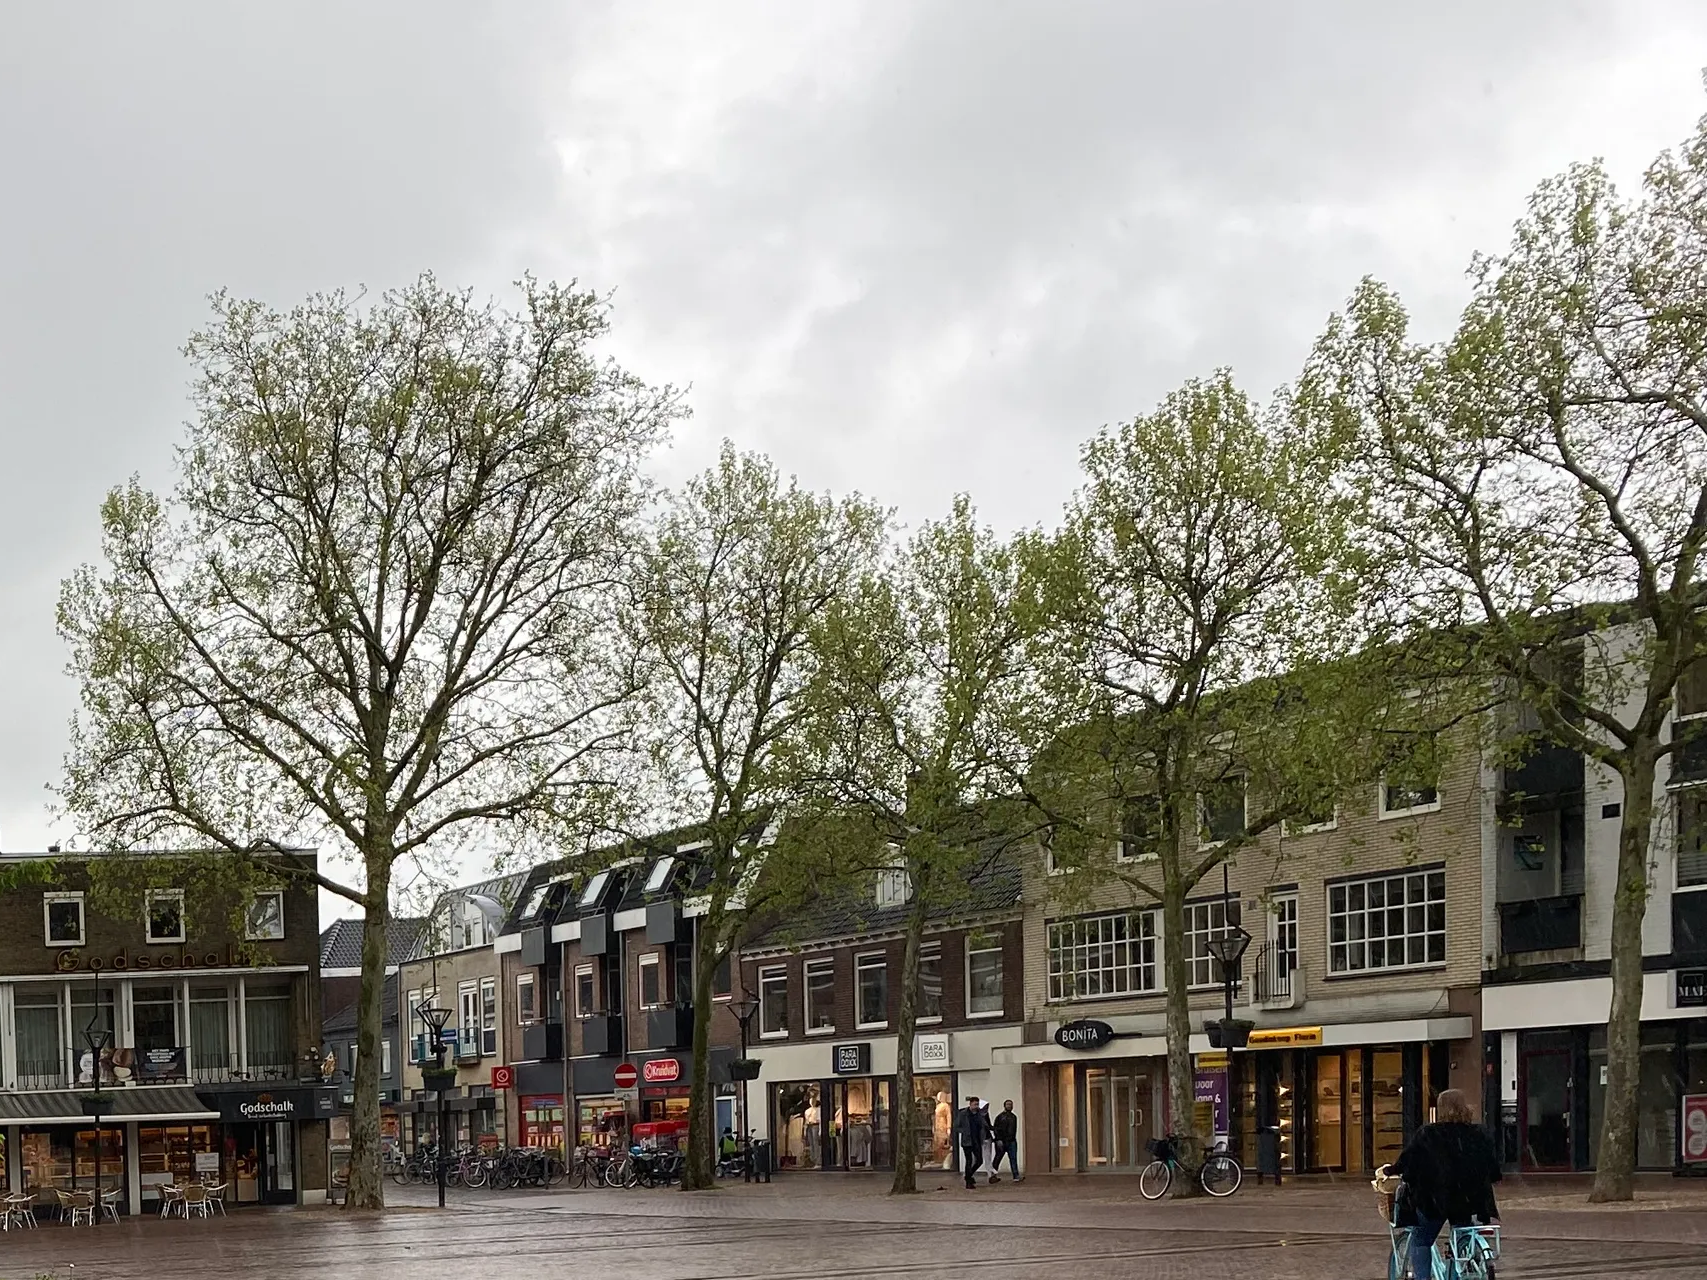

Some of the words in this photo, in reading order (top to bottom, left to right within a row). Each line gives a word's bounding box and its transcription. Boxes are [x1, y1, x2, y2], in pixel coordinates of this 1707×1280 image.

[56, 944, 260, 971] Godschal
[1062, 1026, 1098, 1043] BONITA
[840, 1050, 856, 1059] PARA
[1215, 1094, 1221, 1103] &
[240, 1100, 294, 1115] Godschalk
